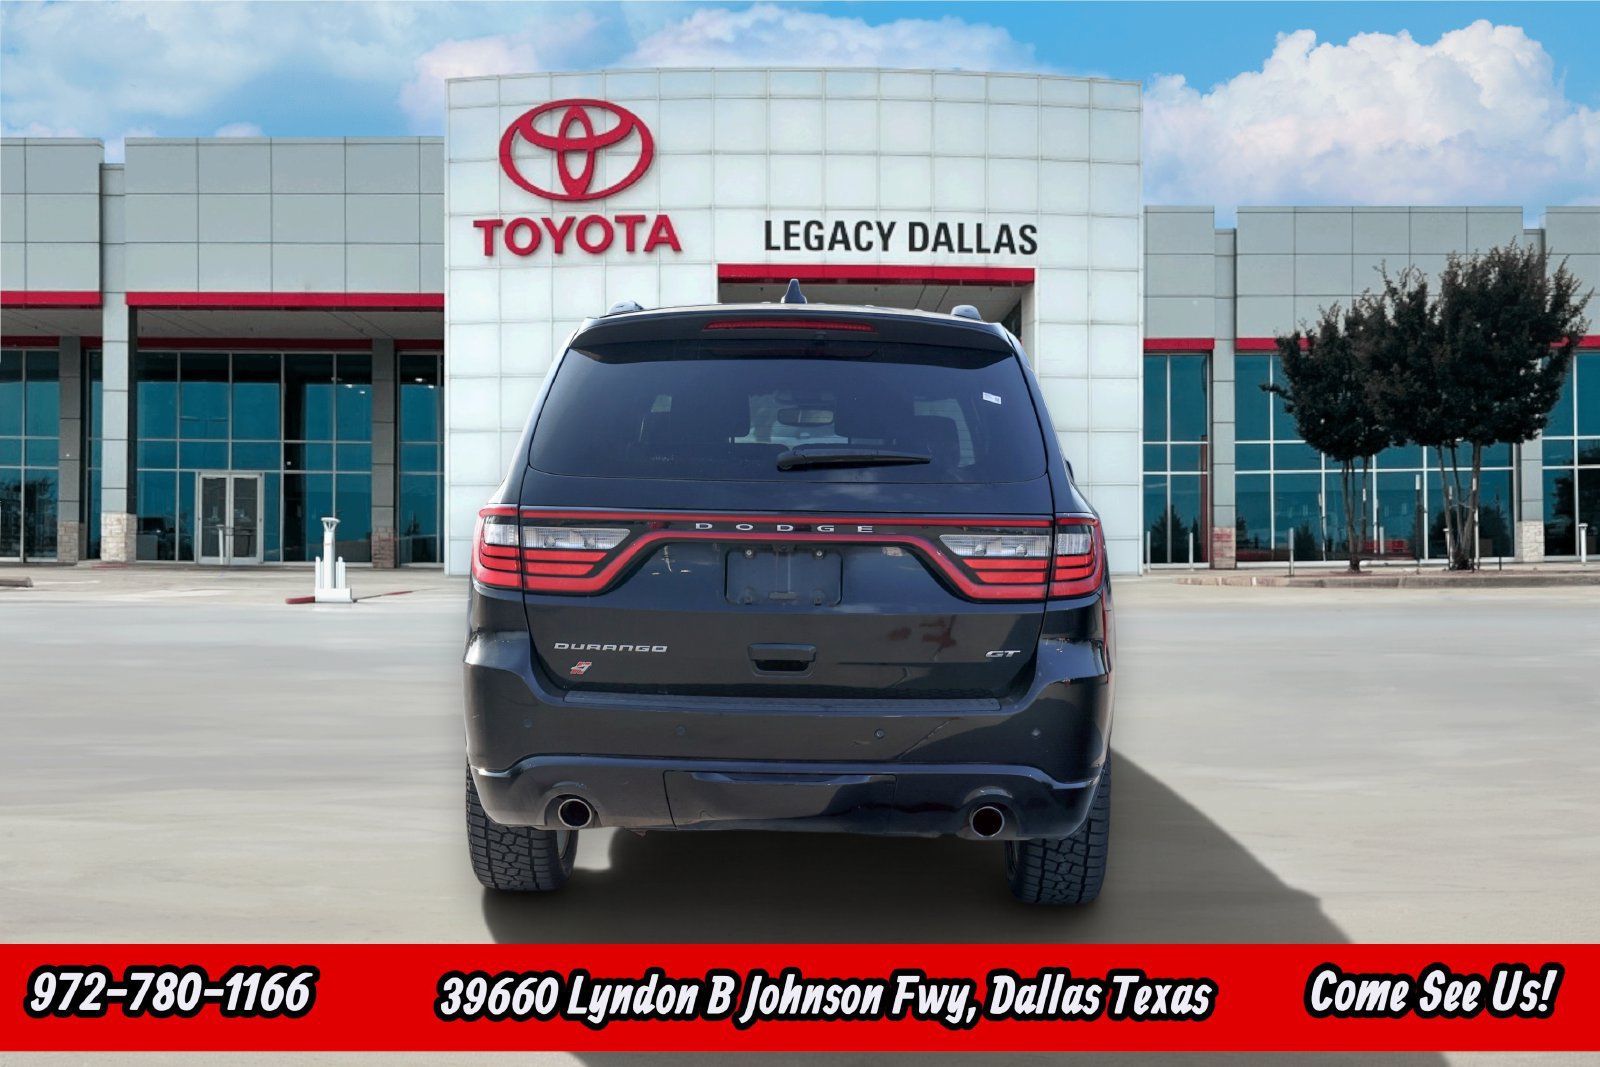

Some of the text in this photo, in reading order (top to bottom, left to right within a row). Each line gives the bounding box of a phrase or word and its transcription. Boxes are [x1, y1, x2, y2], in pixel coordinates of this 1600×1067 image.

[474, 214, 682, 257] TOYOTA
[764, 220, 1039, 255] LEGACY DALLAS
[695, 522, 873, 533] DODGE
[553, 642, 668, 653] DURANGO
[985, 650, 1021, 658] GT
